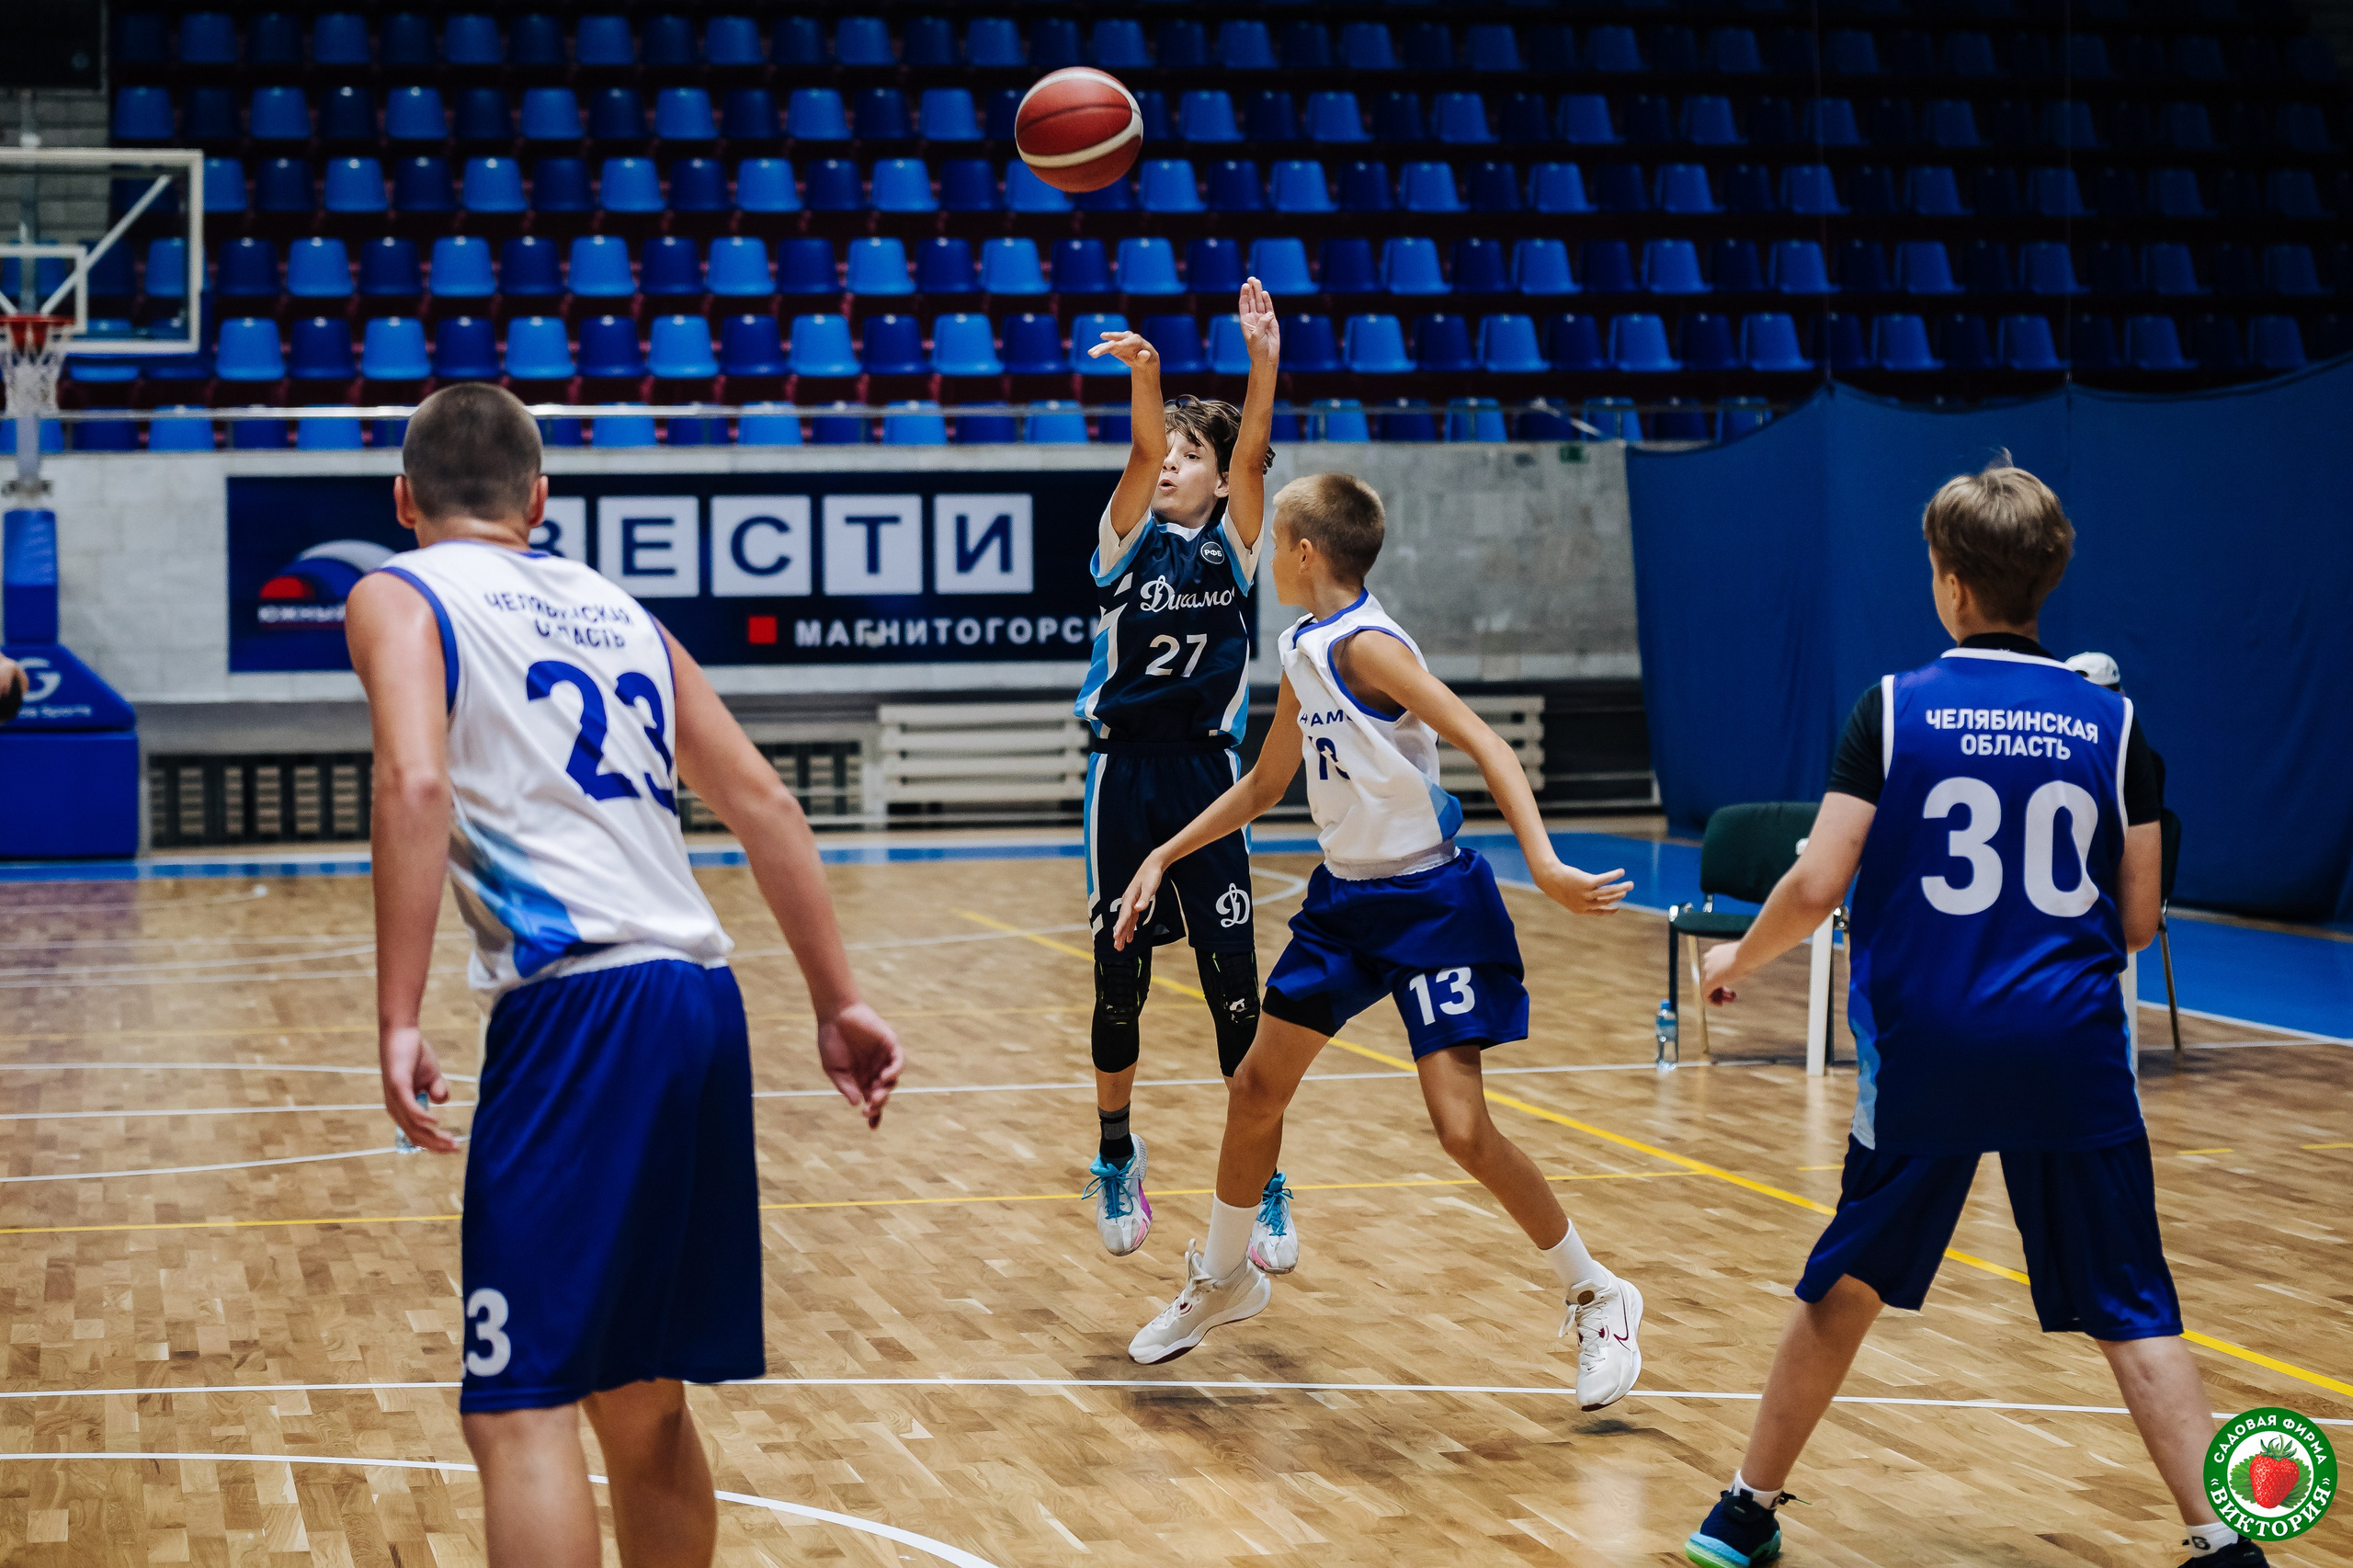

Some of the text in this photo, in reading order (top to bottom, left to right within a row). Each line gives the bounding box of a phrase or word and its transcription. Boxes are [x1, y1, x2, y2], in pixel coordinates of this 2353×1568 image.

[1203, 549, 1222, 558] РФБ
[1145, 633, 1208, 677] 27
[526, 660, 677, 817] 23
[1925, 708, 2098, 744] ЧЕЛЯБИНСКАЯ
[1961, 733, 2071, 760] ОБЛАСТЬ
[1921, 776, 2099, 917] 30
[1409, 966, 1475, 1026] 13
